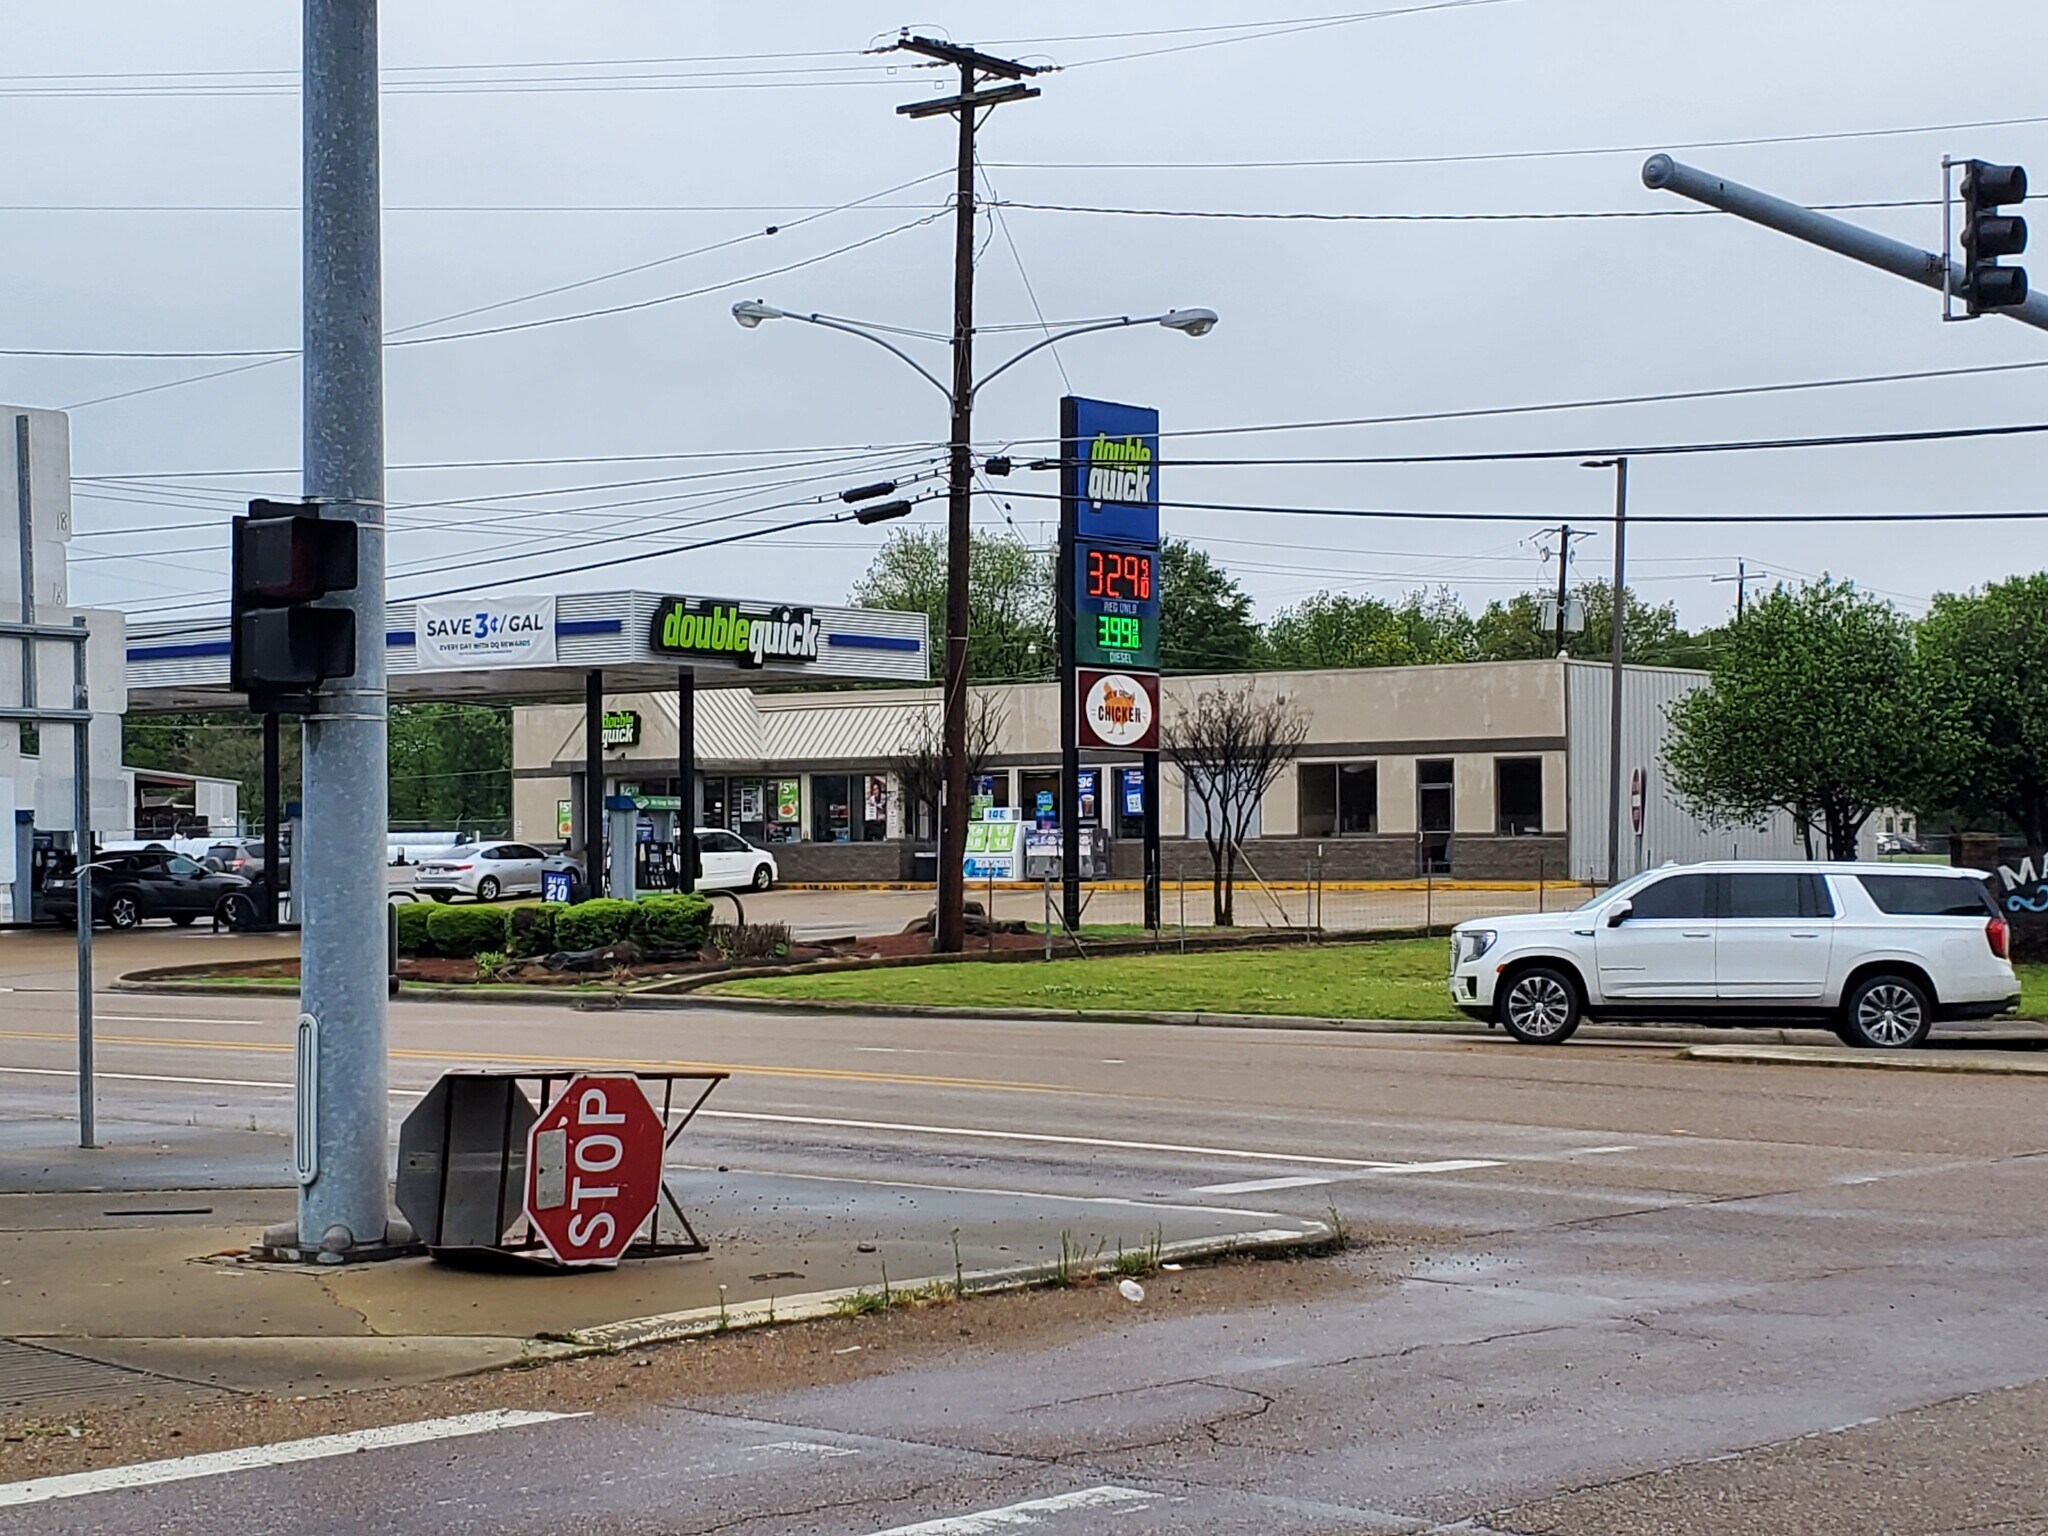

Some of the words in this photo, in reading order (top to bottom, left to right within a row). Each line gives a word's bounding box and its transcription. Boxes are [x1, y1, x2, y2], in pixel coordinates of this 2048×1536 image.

[1091, 432, 1151, 471] double
[1088, 464, 1151, 509] quick
[426, 618, 472, 637] SAVE
[1098, 705, 1141, 723] CHICKEN
[602, 723, 634, 748] quick
[546, 884, 568, 901] 20
[567, 1088, 626, 1249] STOP
